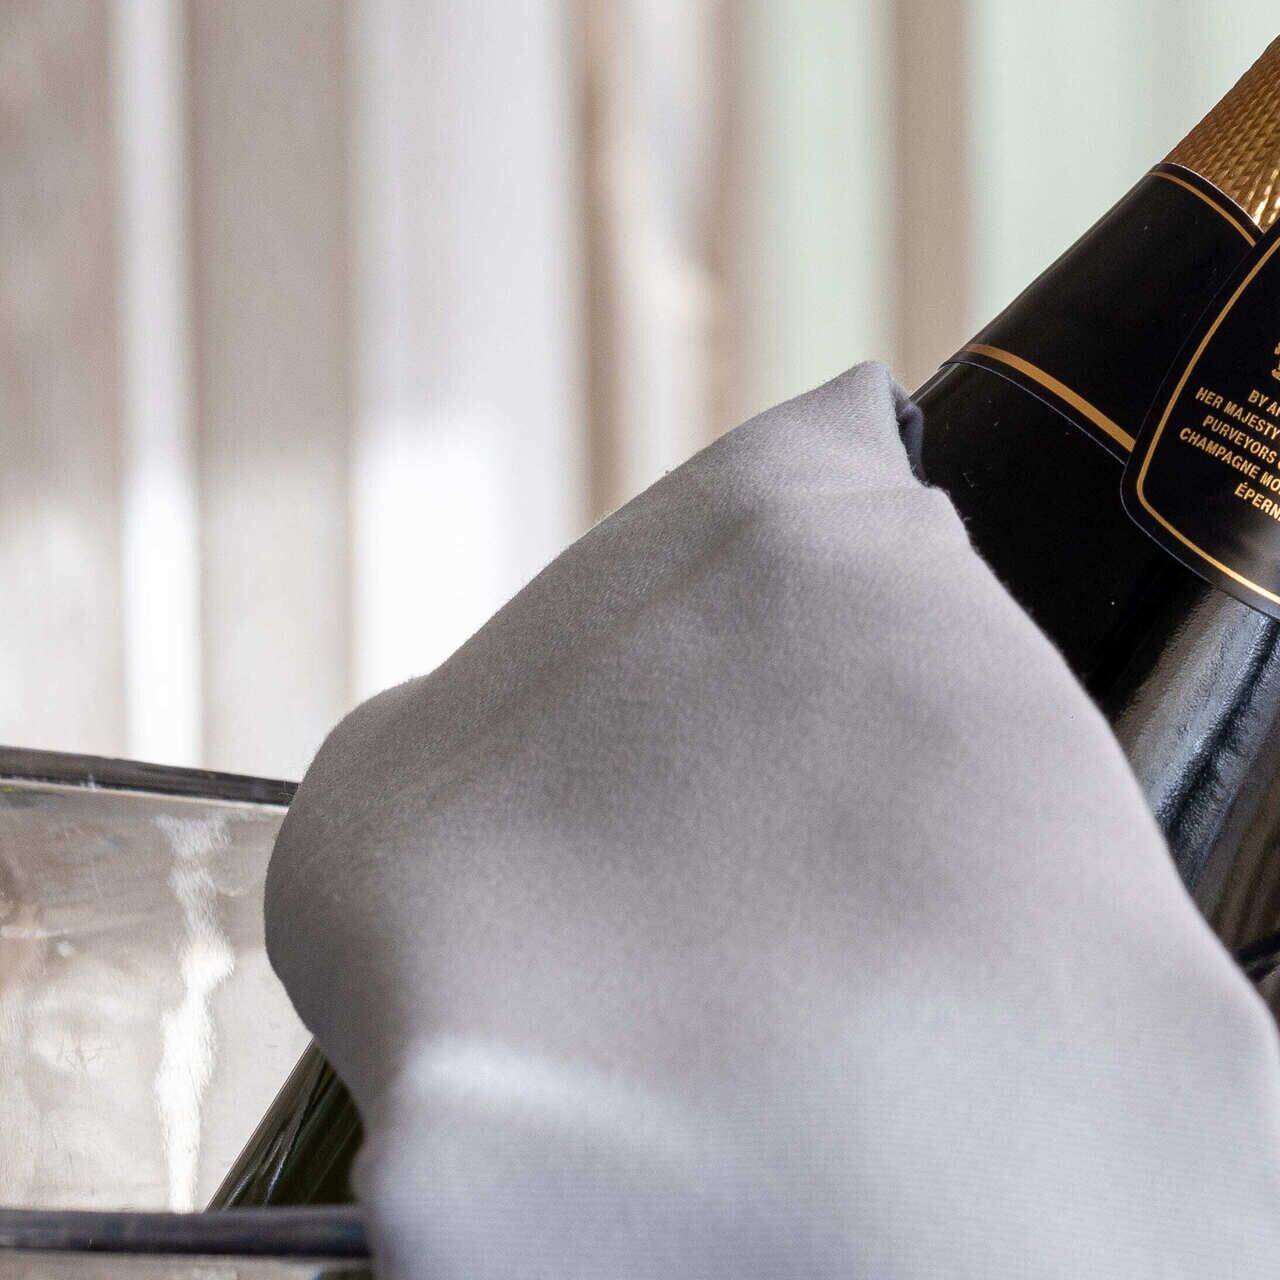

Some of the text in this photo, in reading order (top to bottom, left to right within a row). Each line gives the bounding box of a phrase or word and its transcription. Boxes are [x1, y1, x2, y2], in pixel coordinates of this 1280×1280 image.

[1196, 388, 1222, 410] HER
[1224, 402, 1280, 441] MAJESTY
[1248, 390, 1266, 407] BY
[1180, 428, 1260, 479] CHAMPAGNE
[1202, 416, 1276, 463] PURVEYORS
